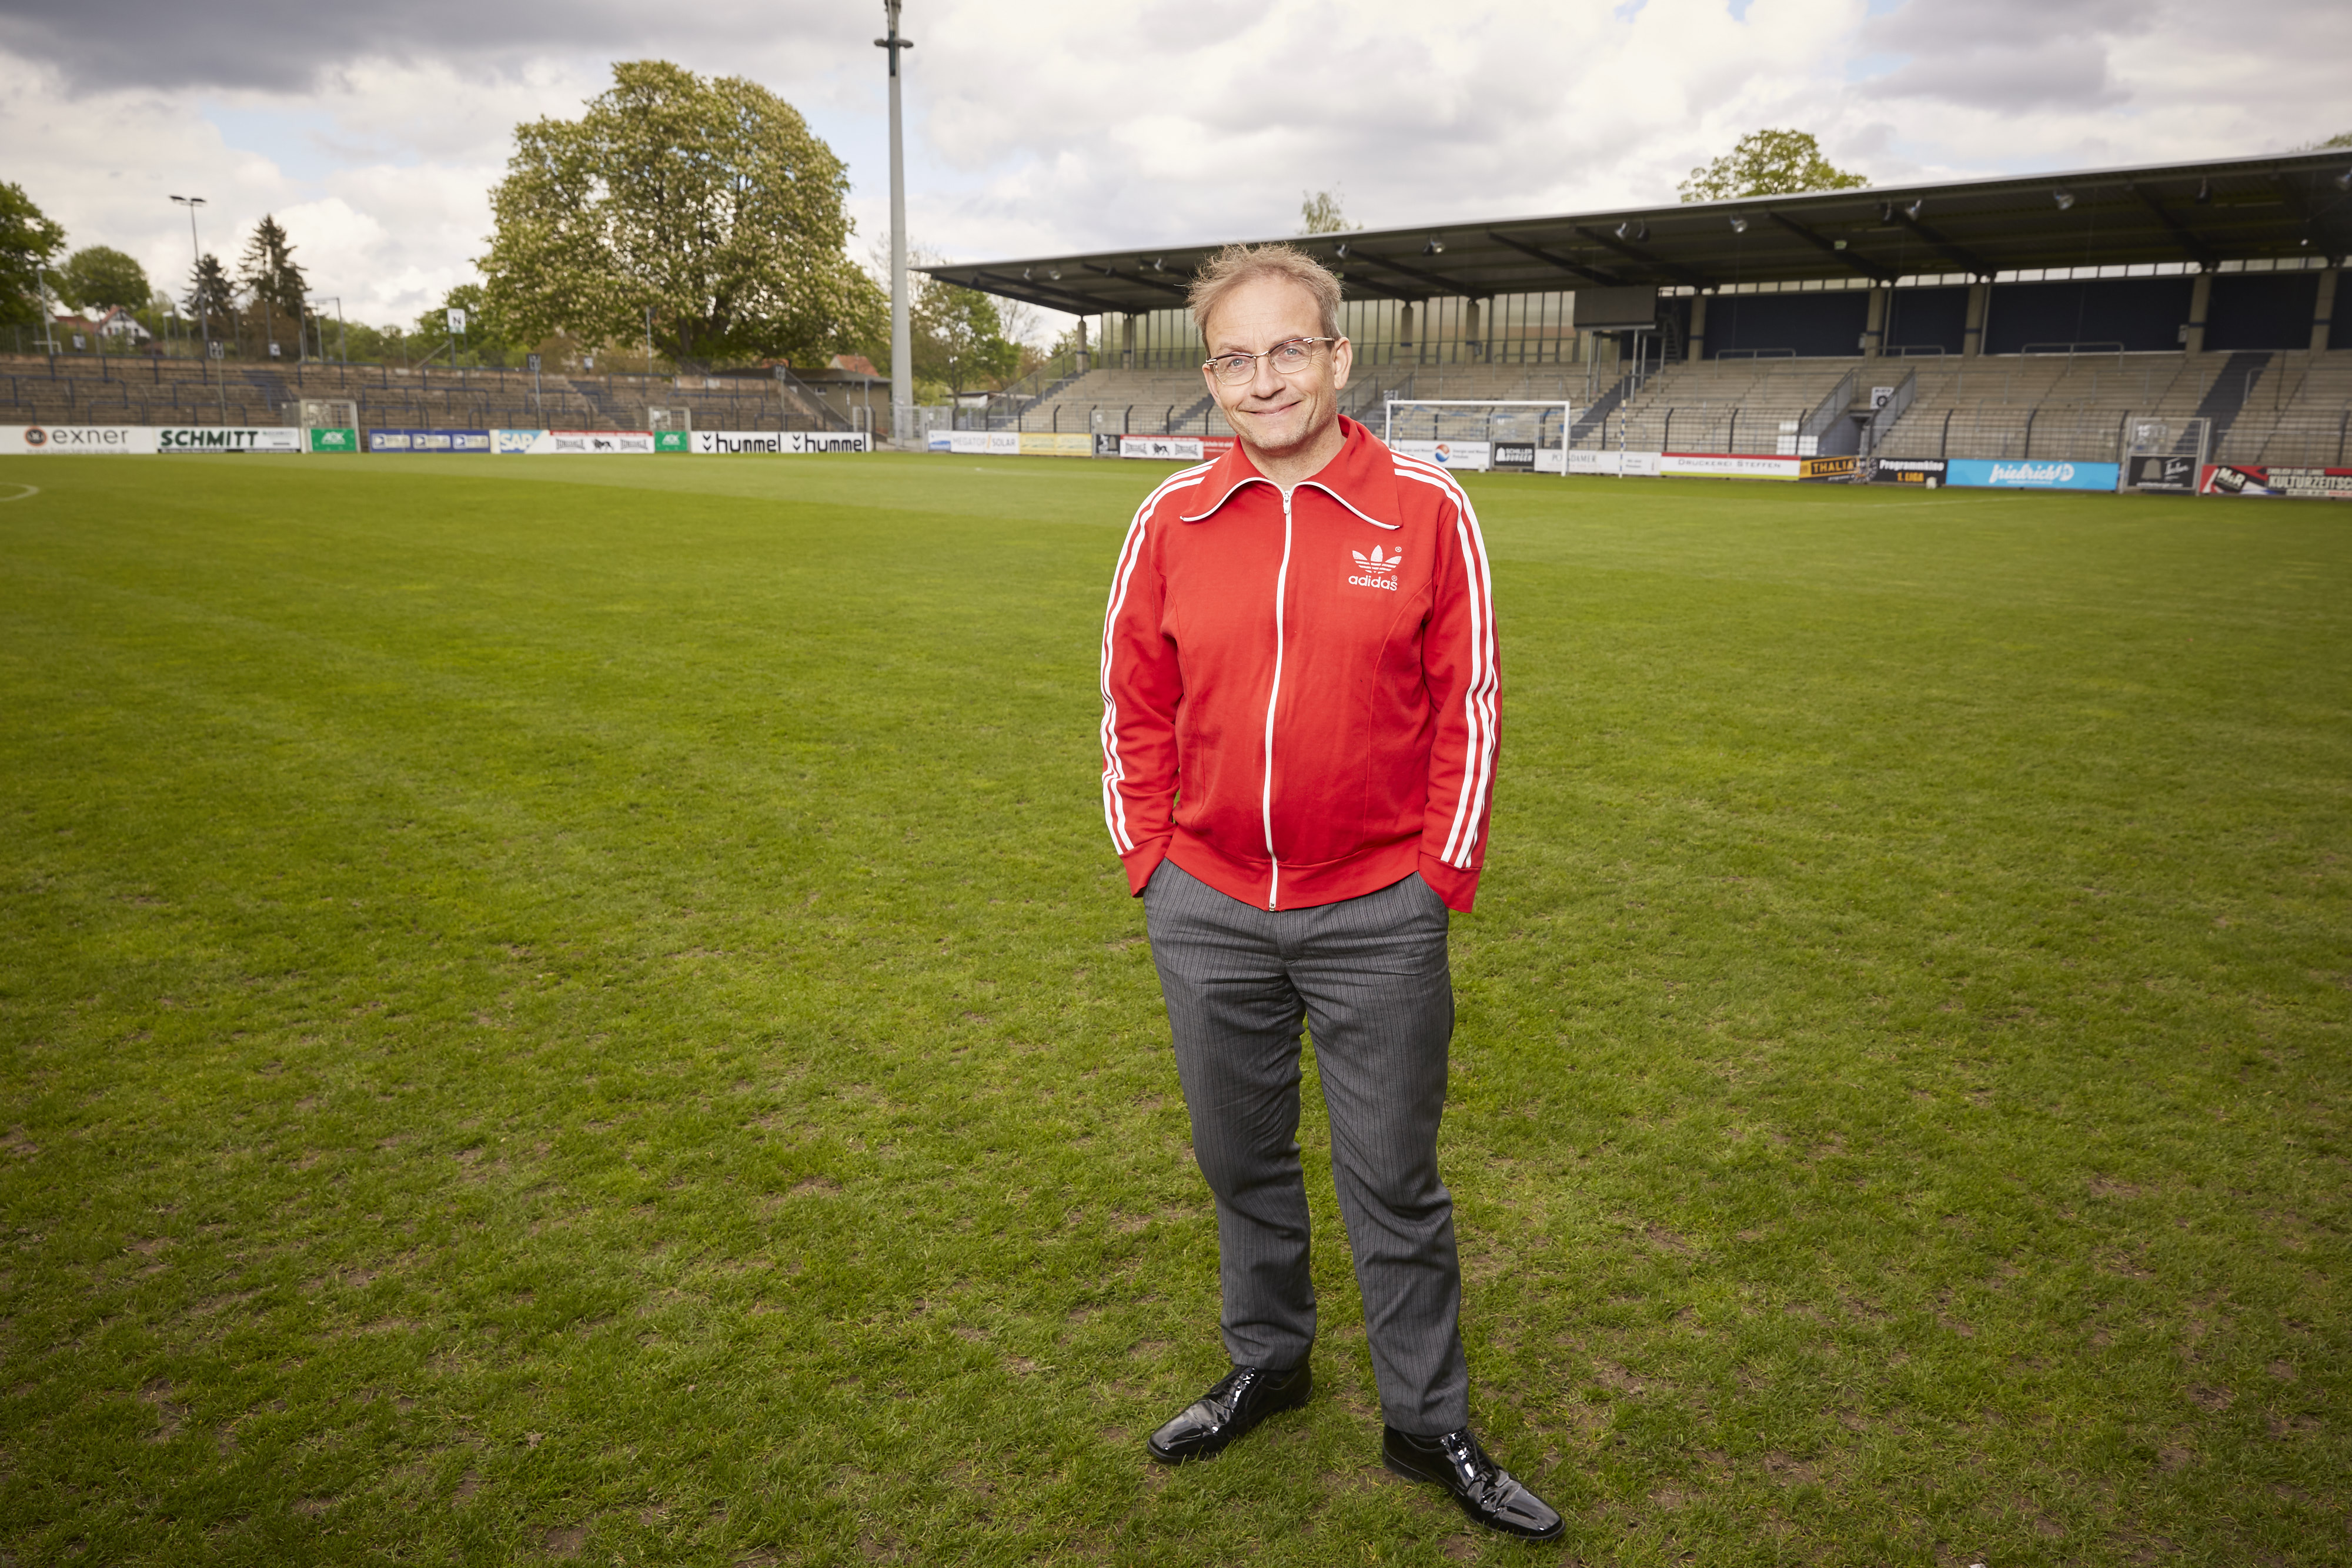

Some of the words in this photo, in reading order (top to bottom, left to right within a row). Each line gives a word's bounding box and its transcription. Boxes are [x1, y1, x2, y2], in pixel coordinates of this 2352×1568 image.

[52, 429, 129, 444] exner
[161, 430, 258, 447] SCHMITT
[500, 433, 534, 451] SAP
[716, 433, 781, 452] hummel
[805, 433, 866, 452] hummel
[992, 437, 1016, 446] SOLAR
[1813, 459, 1855, 473] THALIA
[1348, 575, 1398, 591] adidas
